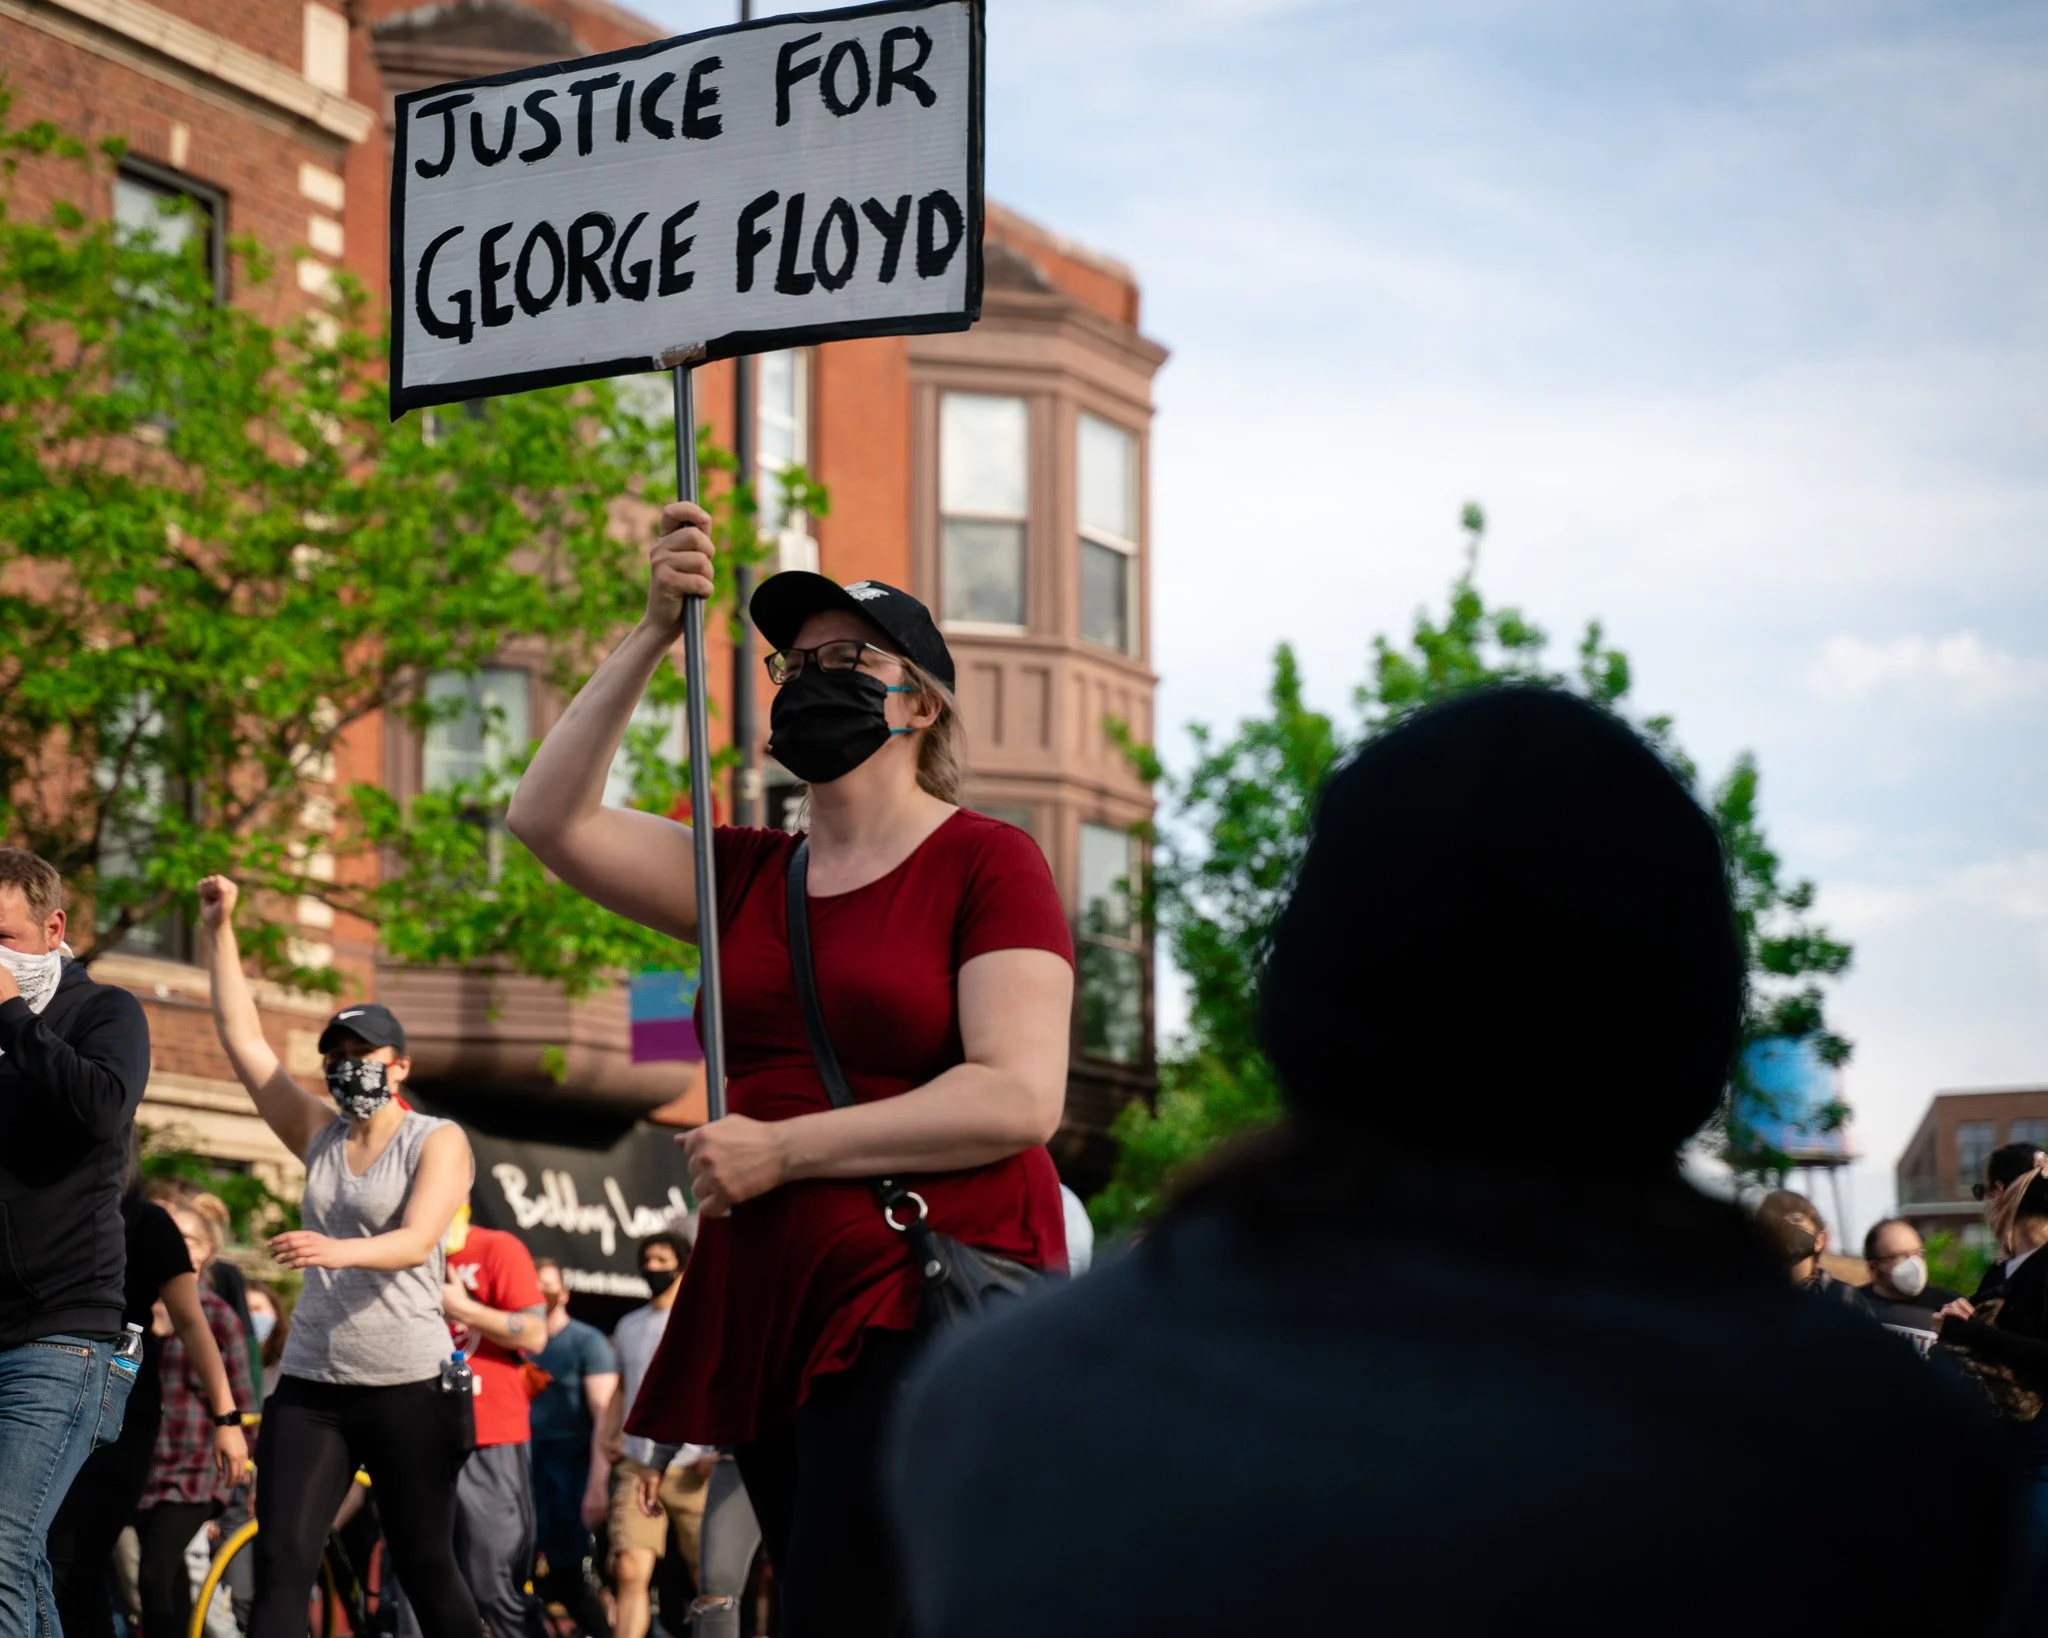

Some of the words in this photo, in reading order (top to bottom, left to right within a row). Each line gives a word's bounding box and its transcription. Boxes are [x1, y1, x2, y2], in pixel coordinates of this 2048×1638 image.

[415, 56, 724, 179] JUSTICE
[776, 26, 937, 127] FOR
[415, 201, 699, 344] GEORGE
[736, 189, 965, 295] FLOYD
